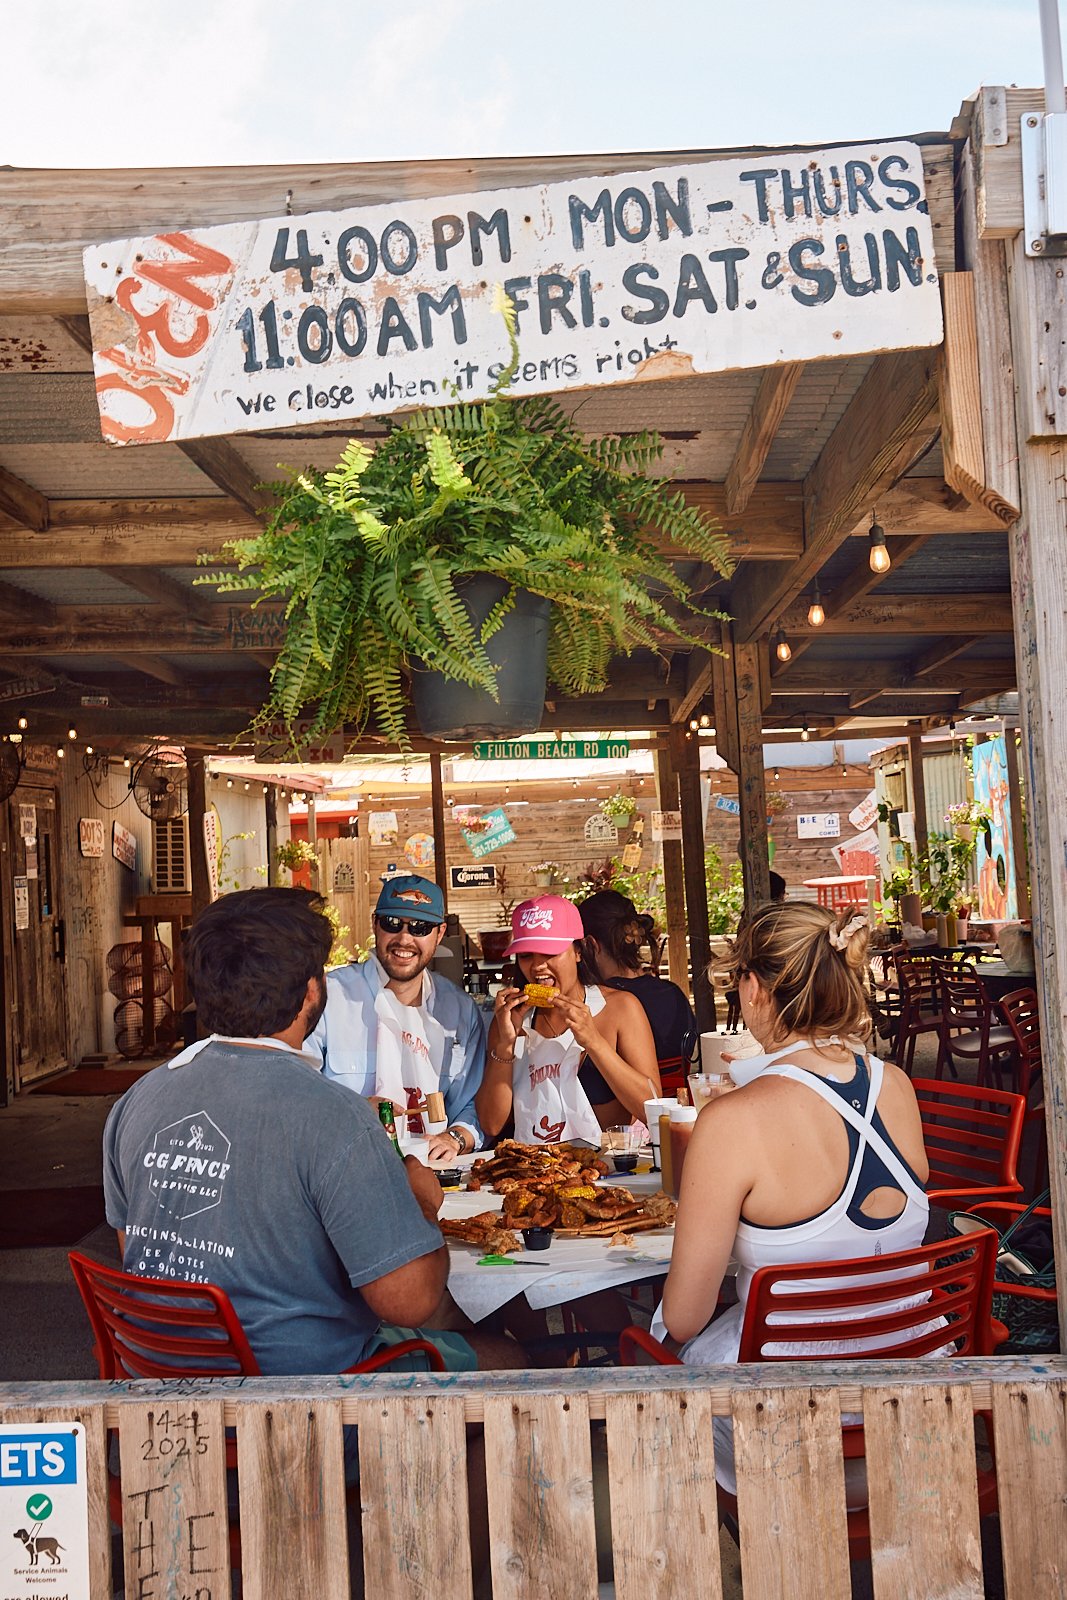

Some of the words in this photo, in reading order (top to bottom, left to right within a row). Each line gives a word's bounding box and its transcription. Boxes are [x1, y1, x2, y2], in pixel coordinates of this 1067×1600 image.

[761, 251, 783, 289] &
[790, 227, 938, 307] SUN.
[289, 383, 355, 411] close
[368, 371, 439, 401] when
[453, 359, 479, 390] it
[309, 748, 334, 761] IN
[474, 744, 481, 759] S
[488, 743, 530, 759] FULTON
[537, 742, 577, 758] BEACH
[583, 742, 599, 757] RD
[606, 745, 628, 759] 100
[457, 871, 489, 884] Corona
[520, 906, 553, 927] Texan
[143, 1152, 170, 1170] CG
[170, 1154, 231, 1180] FENCE
[200, 1186, 218, 1198] LLC
[1, 1441, 65, 1478] ETS
